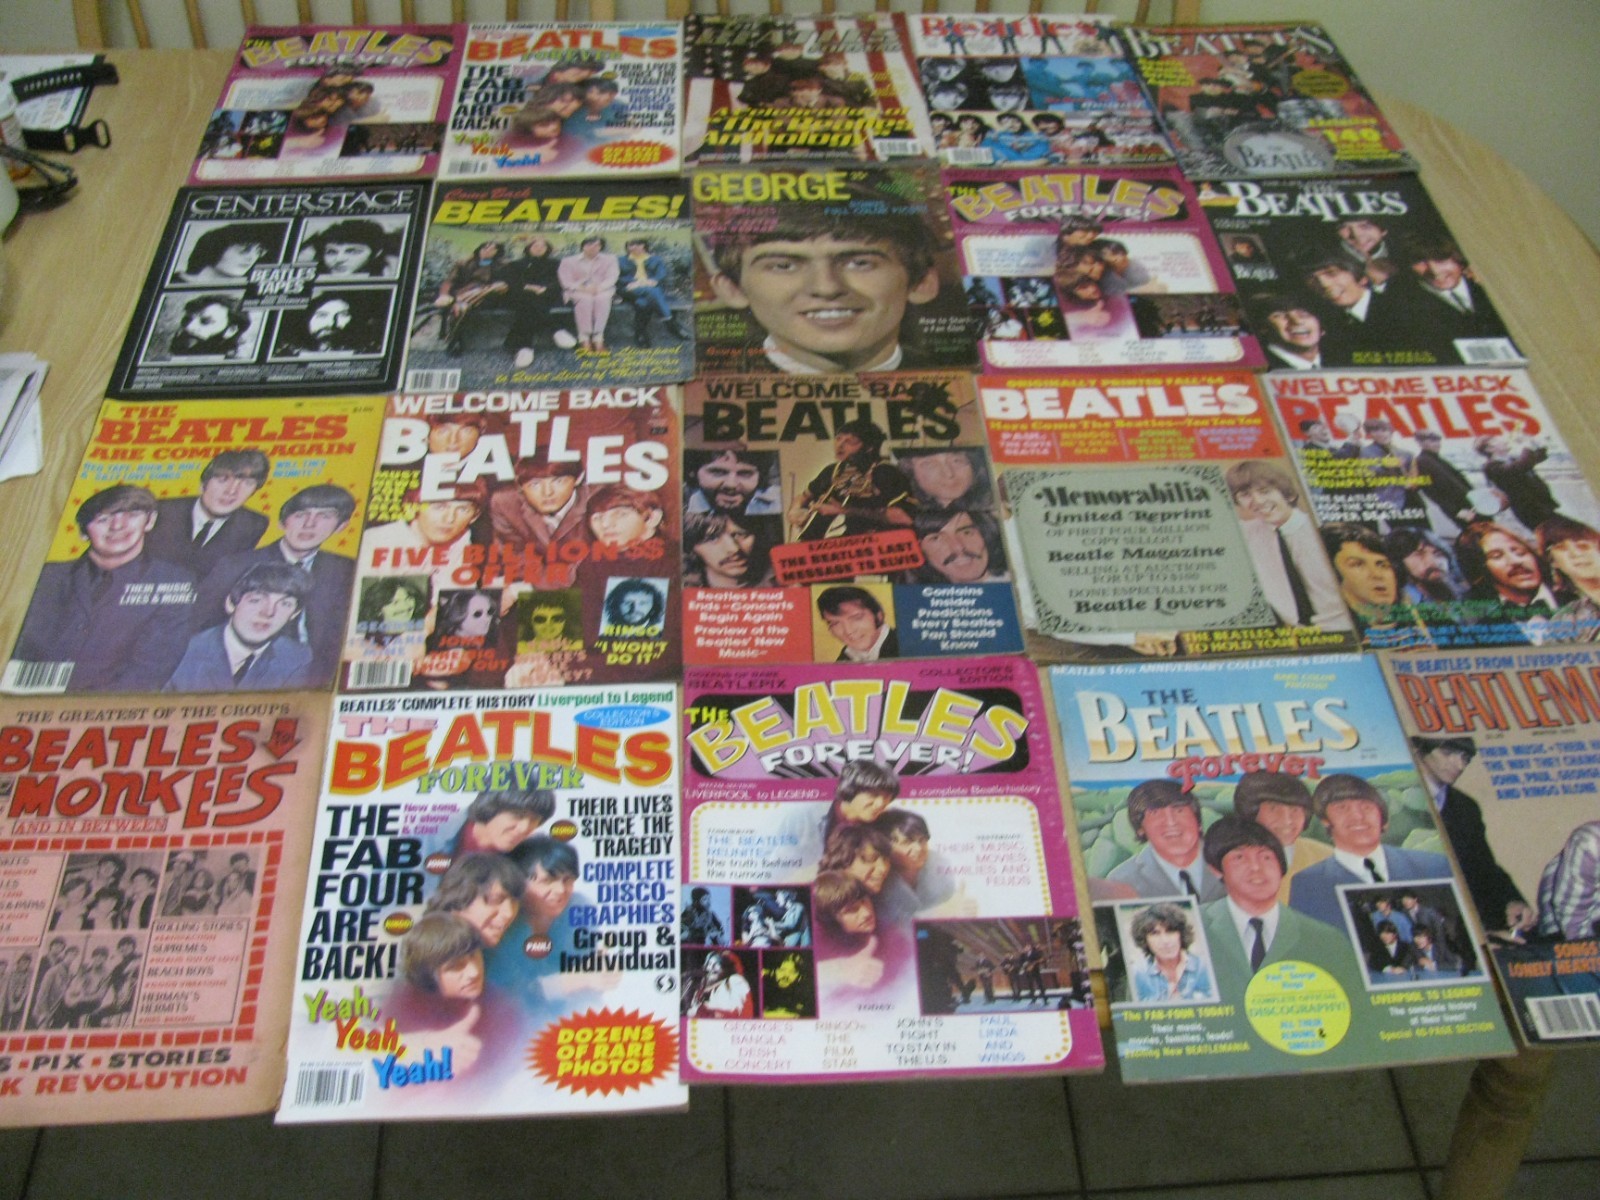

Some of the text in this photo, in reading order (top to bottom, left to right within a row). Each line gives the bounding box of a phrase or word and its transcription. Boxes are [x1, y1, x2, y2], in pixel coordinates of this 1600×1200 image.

[241, 29, 454, 67] BEATLES
[467, 30, 677, 61] BEATLES
[465, 64, 512, 78] THE
[463, 77, 524, 90] FAB
[458, 91, 527, 104] FOUR
[455, 105, 494, 117] ARE
[451, 117, 509, 131] BACK!
[493, 152, 541, 169] Yeah!
[691, 171, 852, 203] GEORGE
[944, 185, 978, 197] THE
[950, 173, 1186, 222] BEATLES
[431, 194, 686, 225] BEATLES!
[1222, 181, 1409, 222] BEATLES
[1003, 203, 1150, 222] FOREVER!
[249, 267, 317, 282] BEATLES
[257, 281, 305, 296] TAPES
[706, 381, 862, 400] WELCOME
[1271, 375, 1522, 396] WELCOME BACK
[394, 386, 661, 415] WELCOME BACK
[981, 383, 1259, 420] BEATLES
[119, 404, 179, 419] THE
[702, 400, 961, 443] BEATLES
[1276, 394, 1541, 441] BEATLES
[94, 414, 349, 445] BEATLES
[88, 446, 148, 461] ARE
[271, 443, 357, 457] AGAIN
[380, 410, 669, 501] BEATLES
[1042, 482, 1212, 508] Memorabilia
[1043, 507, 1213, 525] Limited Reprint
[371, 547, 452, 569] FIVE
[462, 541, 620, 564] BILLION
[779, 541, 914, 569] THE BEATLES LAST
[1048, 545, 1226, 563] Beatle Magazine
[452, 562, 571, 586] OFFER
[782, 553, 920, 582] MESSAGE TO ELVIS
[124, 581, 195, 594] THEIR MUSIC,
[696, 590, 784, 602] Beatles Feud
[921, 586, 984, 597] Contains
[119, 592, 198, 606] LIVES & MORE!
[930, 596, 978, 608] Insider
[1075, 597, 1227, 616] Beatle Lovers
[699, 611, 784, 624] Begin Again
[917, 607, 995, 618] Predictions
[603, 624, 661, 638] RINGO
[693, 624, 790, 636] Preview of the
[911, 617, 1004, 631] Every Beatles
[920, 628, 997, 640] Fan Should
[439, 635, 486, 648] JOHN
[756, 636, 786, 647] New
[940, 639, 980, 651] Know
[473, 659, 509, 672] OUT
[1391, 652, 1592, 673] THE BEATLES FROM LIVERPOOL
[402, 695, 473, 711] COMPLETE
[475, 693, 535, 709] HISTORY
[537, 693, 606, 708] Liverpool
[607, 692, 622, 703] to
[624, 690, 674, 704] Legend
[1142, 687, 1198, 706] THE
[16, 703, 291, 723] THE GREATEST OF THE GROUPS
[600, 716, 645, 728] EDITION
[684, 706, 731, 725] THE
[338, 714, 439, 739] THE
[686, 679, 1030, 776] BEATLES
[1075, 697, 1360, 764] BEATLES
[0, 720, 261, 773] BEATLES
[328, 708, 674, 797] BEATLES
[759, 739, 976, 775] FOREVER!
[416, 760, 586, 795] FOREVER
[1167, 752, 1325, 796] Forever
[1496, 781, 1597, 800] AND RINGO ALONE
[567, 795, 674, 818] THEIR LIVES
[16, 817, 167, 835] AND IN BETWEEN
[326, 803, 401, 838] THE
[581, 814, 674, 837] SINCE THE
[320, 838, 422, 871] FAB
[592, 835, 674, 858] TRAGEDY
[583, 860, 675, 880] COMPLETE
[706, 857, 726, 867] the
[761, 856, 803, 867] behind
[706, 868, 726, 879] the
[313, 872, 423, 908] FOUR
[597, 881, 674, 903] DISCO-
[567, 903, 675, 927] GRAPHIES
[306, 908, 380, 944] ARE
[573, 925, 676, 949] Group &
[301, 942, 399, 982] BACK!
[559, 948, 676, 974] Individual
[147, 967, 185, 977] BEACH
[303, 984, 380, 1024] Yeah,
[1388, 1006, 1406, 1017] The
[1407, 1004, 1447, 1015] complete
[334, 1016, 409, 1059] Yeah,
[556, 1024, 656, 1044] DOZENS
[1151, 1023, 1174, 1034] Their
[31, 1047, 232, 1071] PIX STORIES
[556, 1040, 656, 1060] OF RARE
[372, 1045, 454, 1090] Yeah!
[556, 1057, 656, 1078] PHOTOS
[35, 1066, 249, 1096] REVOLUTION
